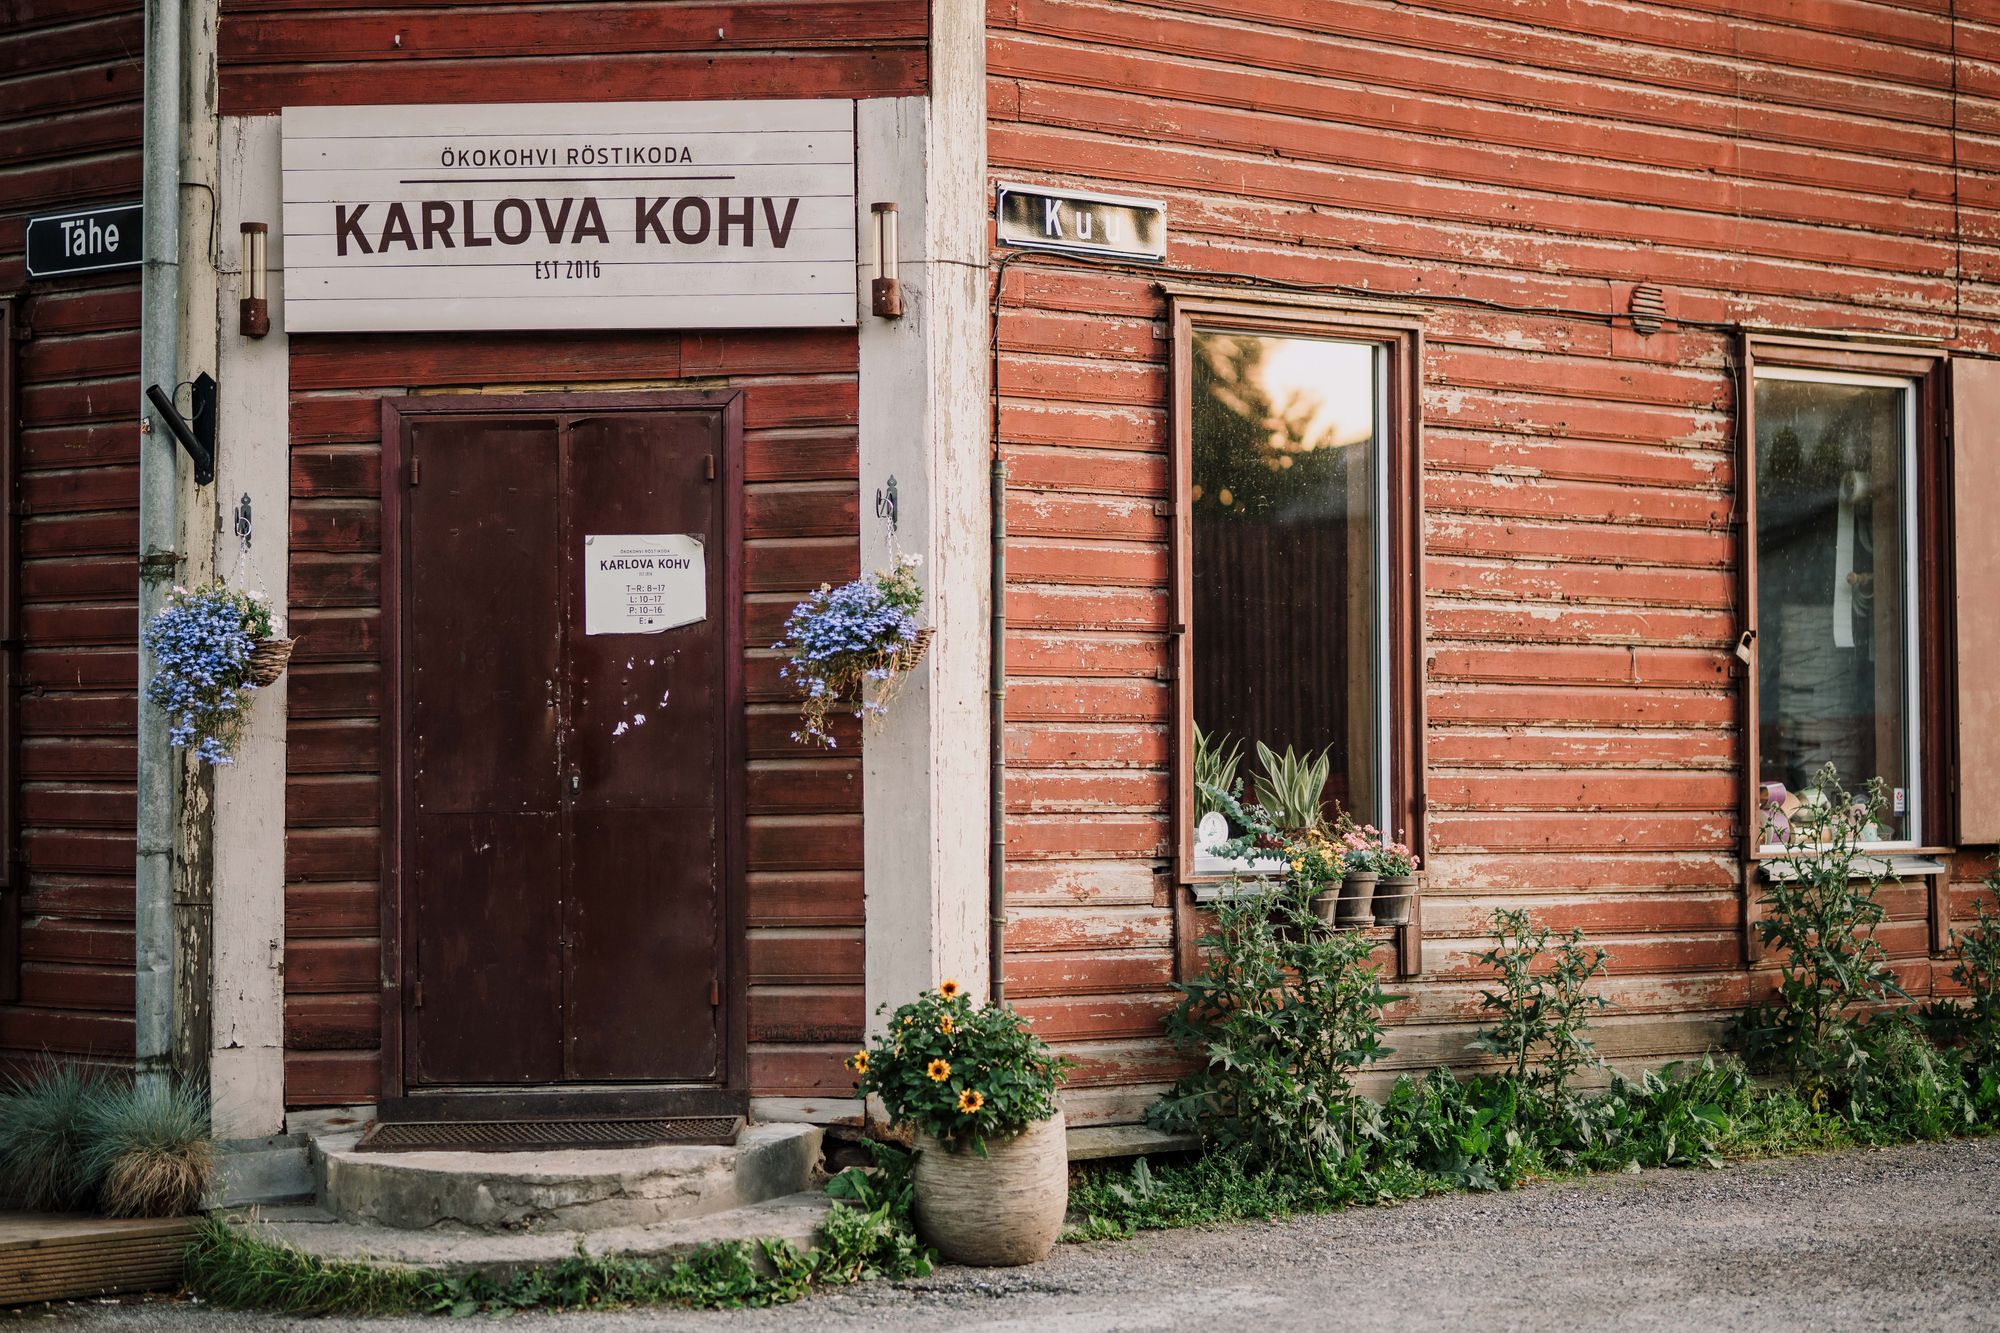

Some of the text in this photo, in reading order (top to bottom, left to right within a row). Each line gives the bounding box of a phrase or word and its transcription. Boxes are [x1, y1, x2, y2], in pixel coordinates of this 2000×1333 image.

[441, 146, 694, 167] ÖKOKOHVI RÖSTIKODA
[335, 196, 799, 256] KARLOVA KOHV
[1045, 199, 1121, 242] Kuu
[60, 218, 119, 257] Tähe
[535, 259, 601, 280] EST 2016
[600, 559, 690, 571] KARLOVA KOHV
[639, 606, 662, 614] 10-16
